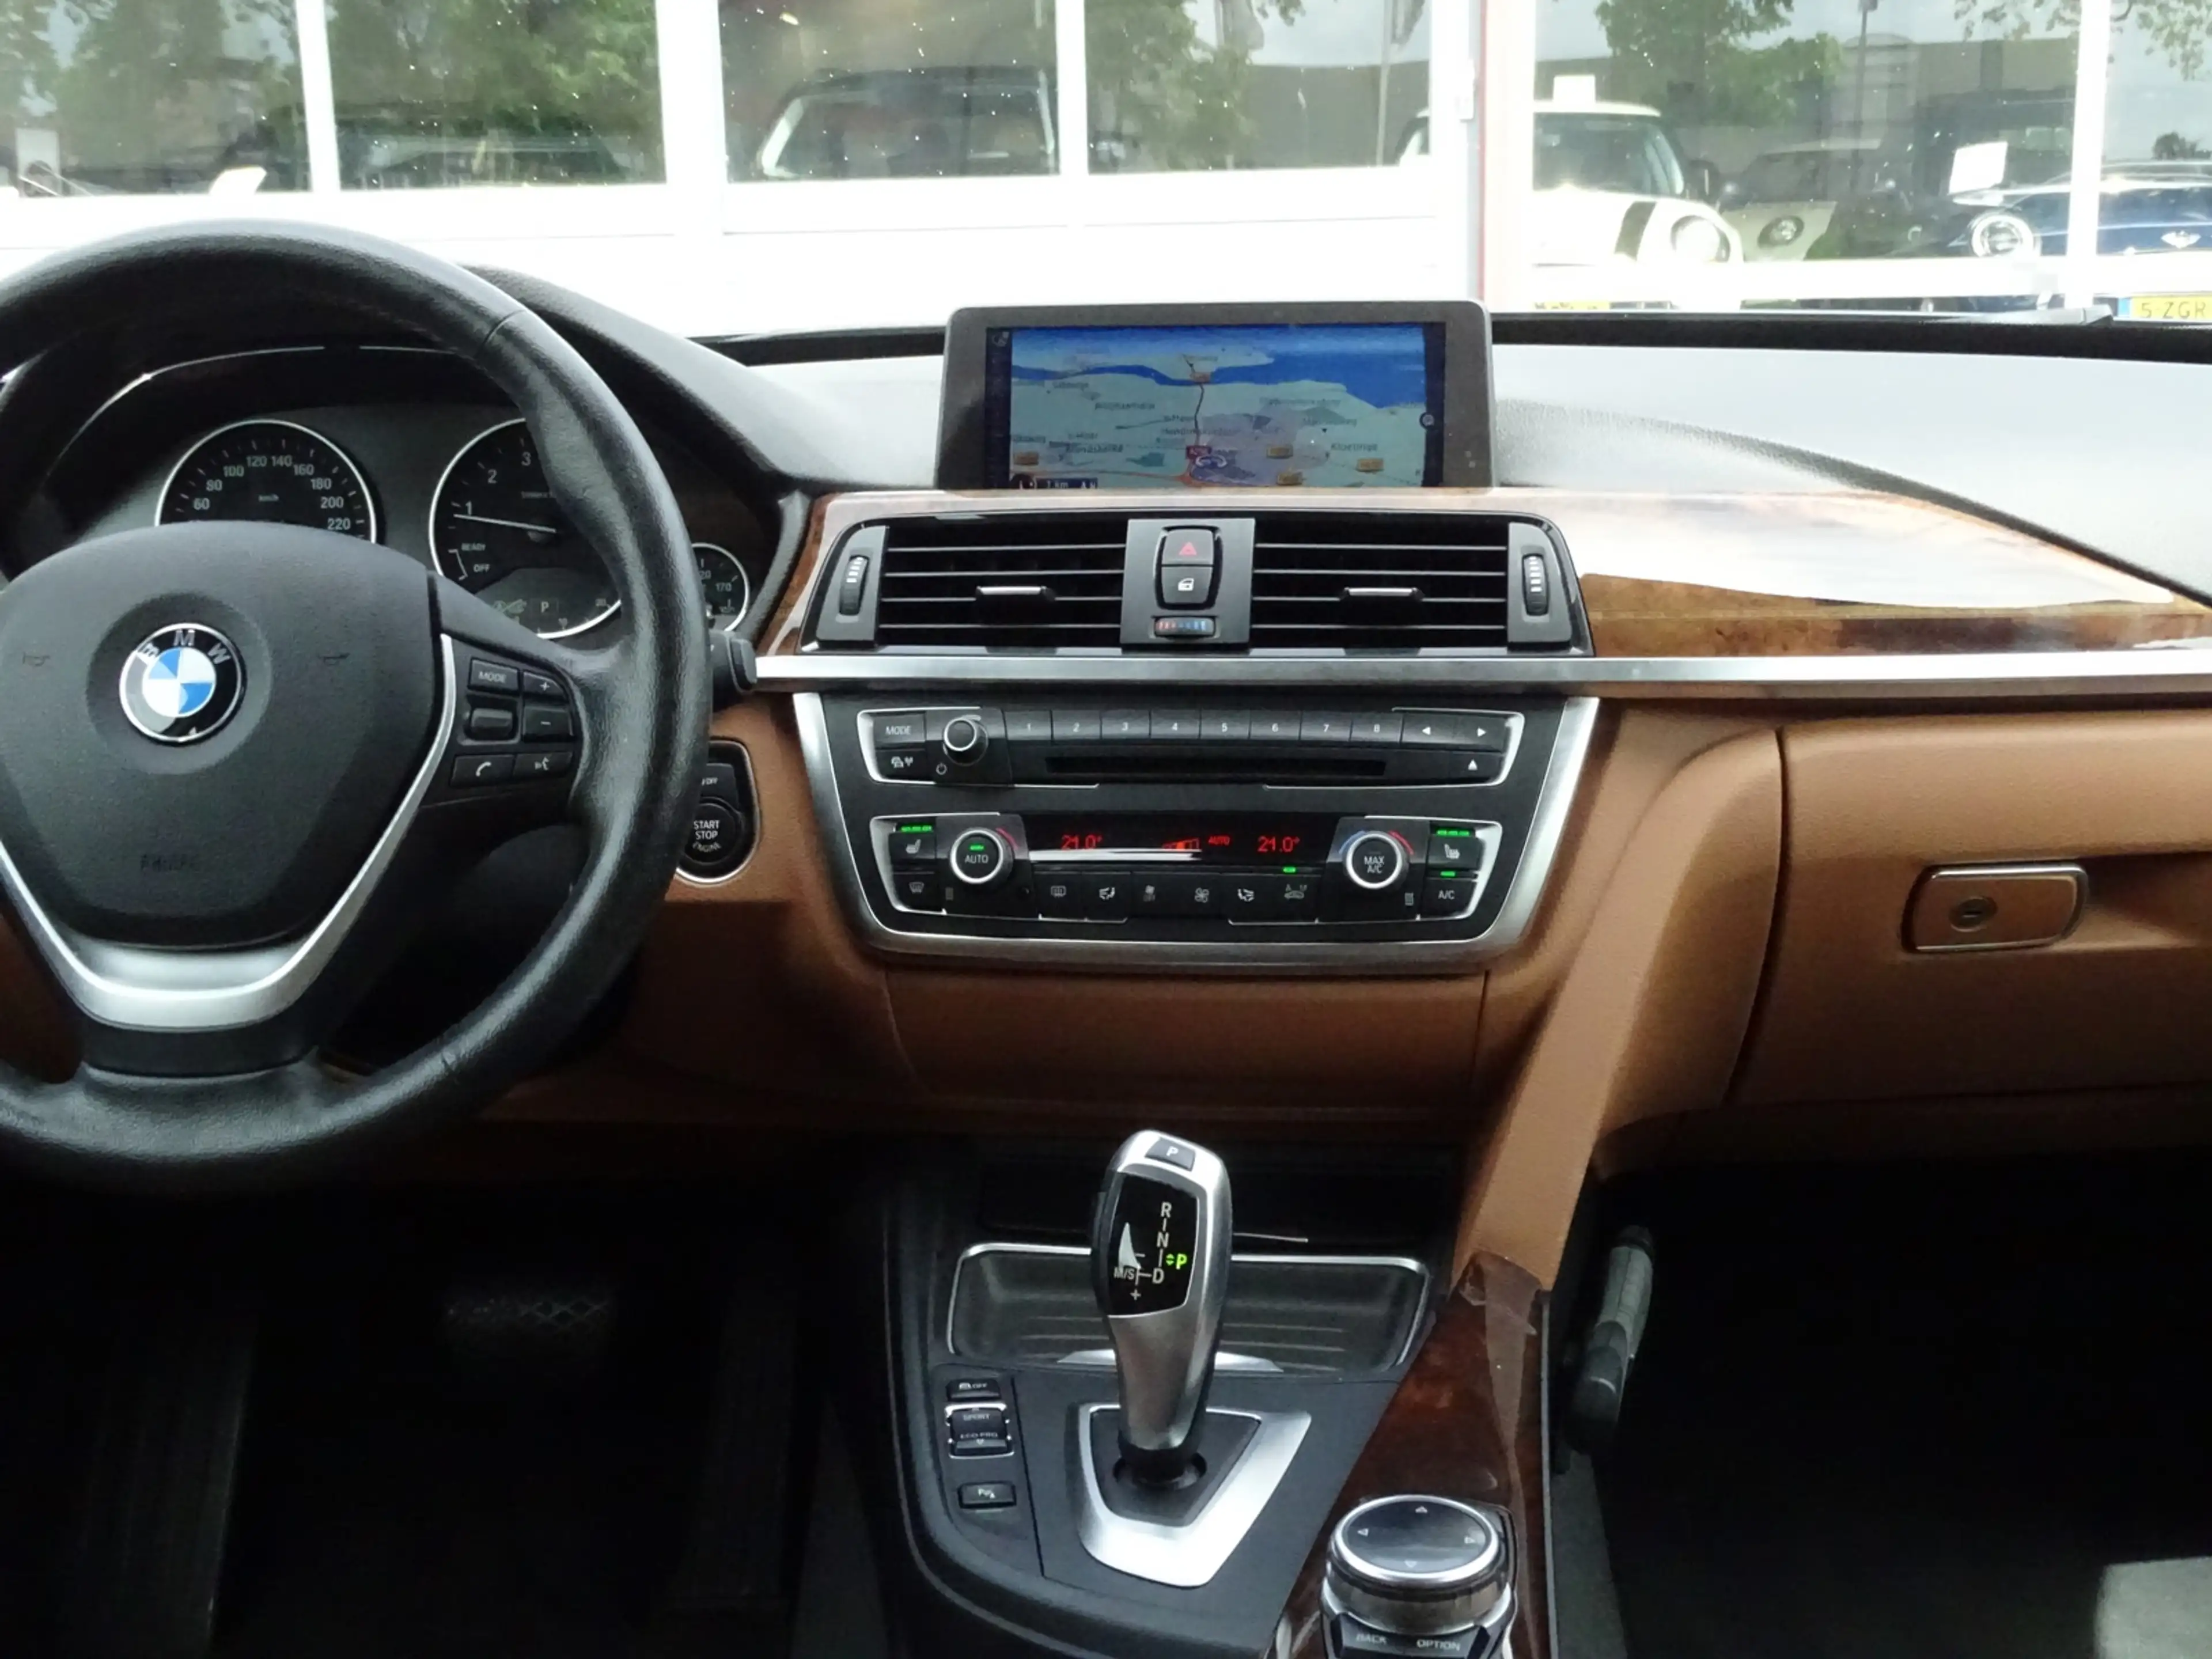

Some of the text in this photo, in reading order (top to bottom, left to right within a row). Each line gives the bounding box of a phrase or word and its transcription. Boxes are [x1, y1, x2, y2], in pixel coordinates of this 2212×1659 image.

[521, 452, 531, 466] 3
[487, 469, 497, 483] 2
[193, 455, 351, 530] 60 80 100 120 140 160 180 200 220
[465, 501, 472, 516] 1
[474, 564, 490, 572] OFF
[715, 582, 732, 592] 170
[541, 601, 549, 613] P
[478, 671, 506, 684] MODE
[885, 726, 911, 735] MODE
[1027, 722, 1380, 733] 1 2 3 4 5 6 7 8
[693, 820, 719, 830] START
[695, 831, 718, 840] STOP
[1209, 836, 1230, 845] AUTO
[964, 854, 989, 863] AUTO
[1364, 855, 1385, 865] MAX
[1367, 865, 1382, 874] A/C
[1438, 890, 1455, 900] A/C
[1166, 1146, 1179, 1156] P
[1161, 1202, 1172, 1218] R
[1157, 1231, 1169, 1248] N
[1176, 1253, 1188, 1270] P
[1113, 1267, 1164, 1284] M/S D
[1356, 1633, 1461, 1652] BACK OPTION
